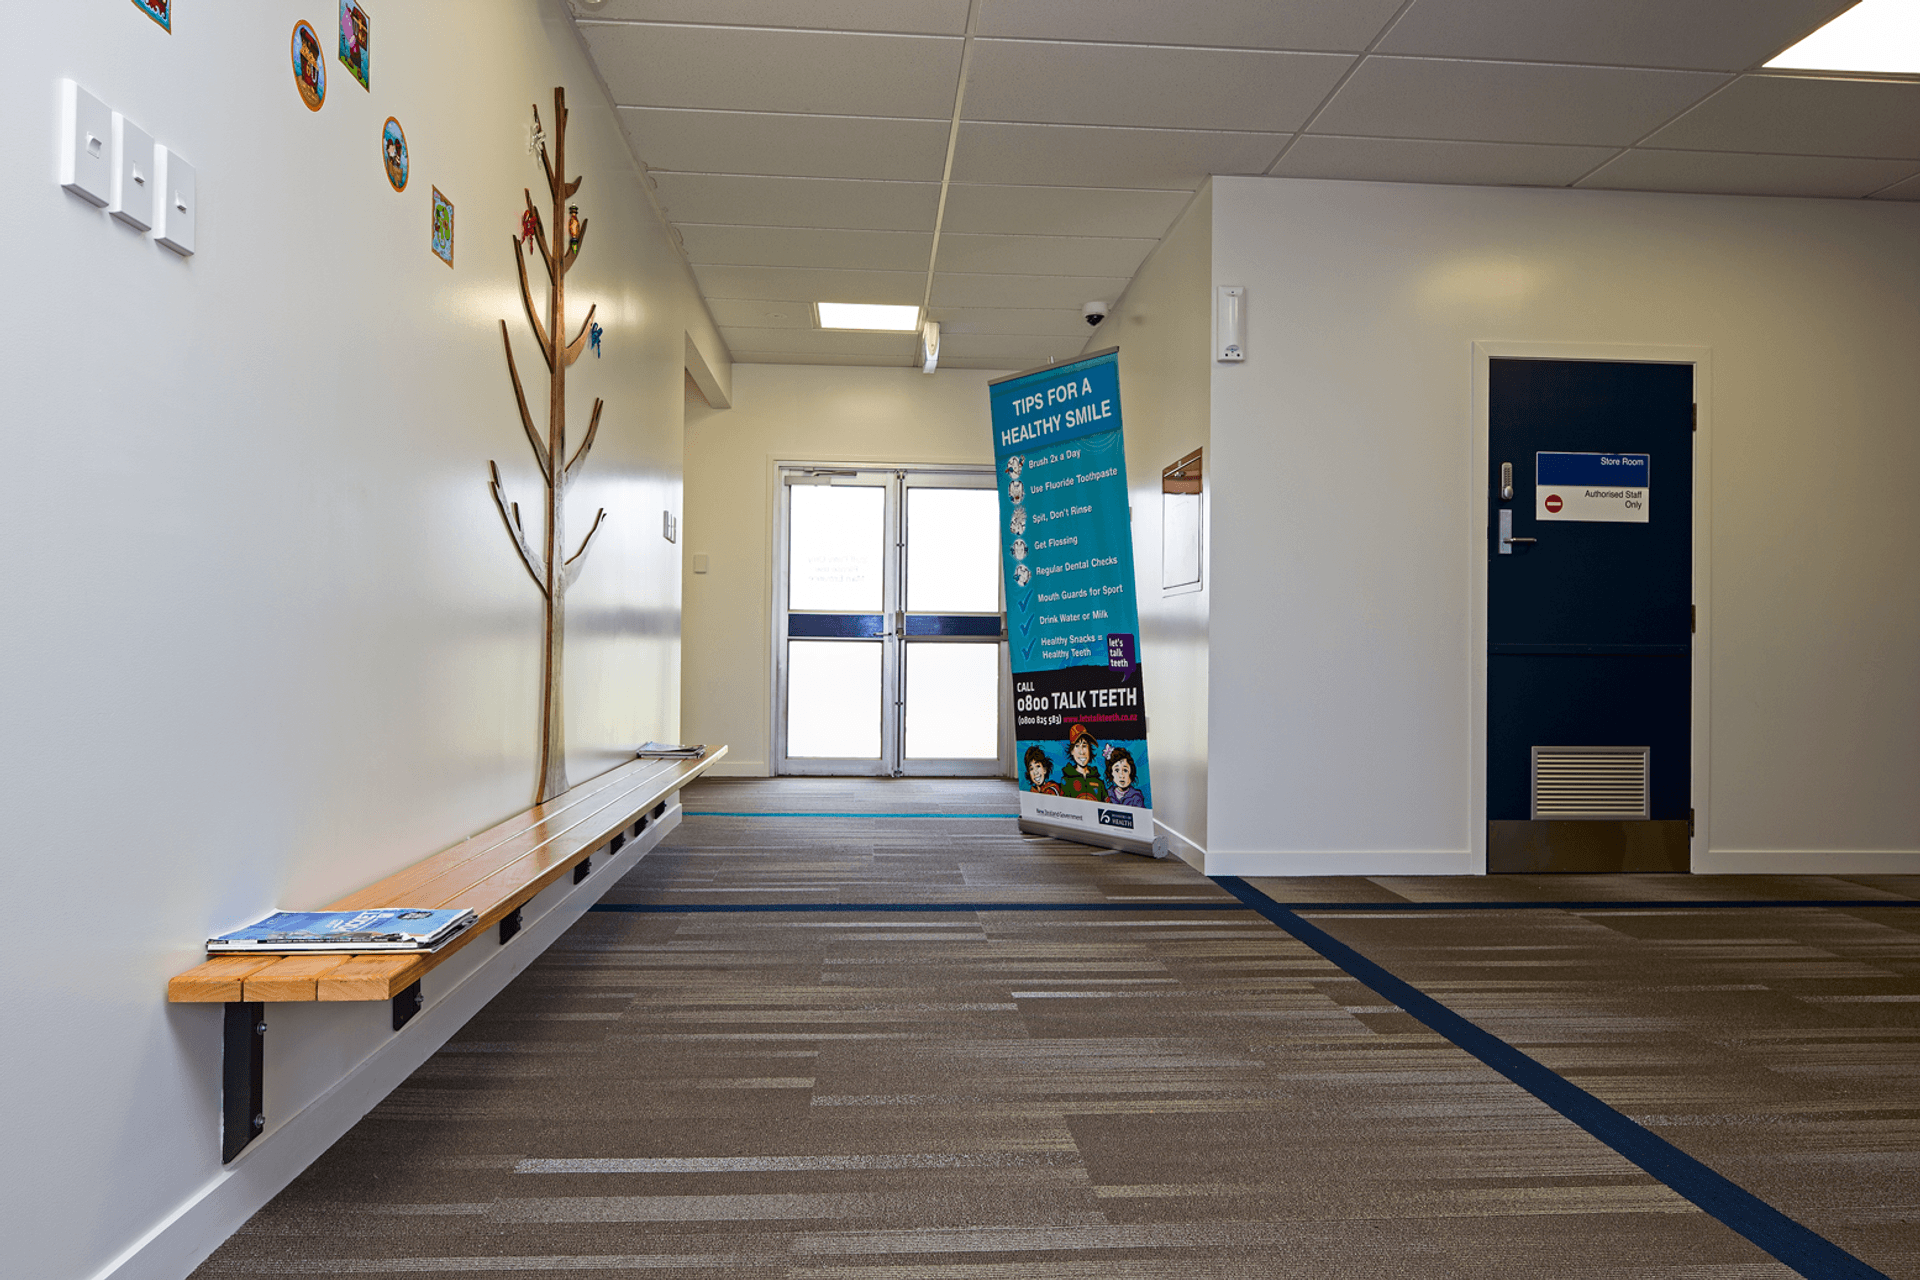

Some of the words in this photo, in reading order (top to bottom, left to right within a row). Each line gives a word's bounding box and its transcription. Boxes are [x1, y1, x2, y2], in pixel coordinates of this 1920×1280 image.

[1012, 392, 1044, 416] TIPS
[1047, 381, 1078, 406] FOR
[1081, 377, 1093, 396] A
[1001, 413, 1061, 447] HEALTHY
[1065, 399, 1112, 428] SMILE
[1028, 457, 1049, 469] Brush
[1050, 454, 1058, 464] 2x
[1059, 453, 1065, 461] a
[1065, 449, 1081, 460] Day
[1600, 456, 1620, 466] Store
[1622, 457, 1644, 466] Room
[1030, 484, 1043, 494] Use
[1045, 477, 1075, 491] Fluoride
[1076, 467, 1118, 484] Toothpaste
[1584, 489, 1624, 498] Authorised
[1625, 490, 1642, 499] Staff
[1625, 500, 1642, 510] Only
[1032, 512, 1049, 525] Spit,
[1049, 508, 1069, 520] Don't
[1070, 505, 1093, 516] Rinse
[1034, 540, 1047, 550] Get
[1048, 536, 1078, 547] Flossing
[1036, 564, 1063, 577] Regular
[1064, 559, 1089, 572] Dental
[1091, 556, 1118, 568] Checks
[1038, 592, 1060, 603] Mouth
[1061, 588, 1088, 600] Guards
[1089, 587, 1101, 597] for
[1102, 584, 1124, 597] Sport
[1039, 615, 1059, 625] Drink
[1059, 613, 1080, 623] Water
[1081, 613, 1090, 621] or
[1092, 609, 1109, 620] Milk
[1041, 636, 1068, 647] Healthy
[1069, 633, 1096, 644] Snacks
[1108, 637, 1124, 647] let's
[1042, 649, 1070, 660] Healthy
[1071, 648, 1092, 658] Teeth
[1109, 648, 1123, 657] talk
[1110, 658, 1129, 668] teeth
[1016, 681, 1035, 693] CALL
[1017, 694, 1049, 712] 0800
[1051, 690, 1087, 710] TALK
[1089, 687, 1137, 708] TEETH
[1018, 715, 1036, 726] (0800
[1036, 715, 1047, 725] 825
